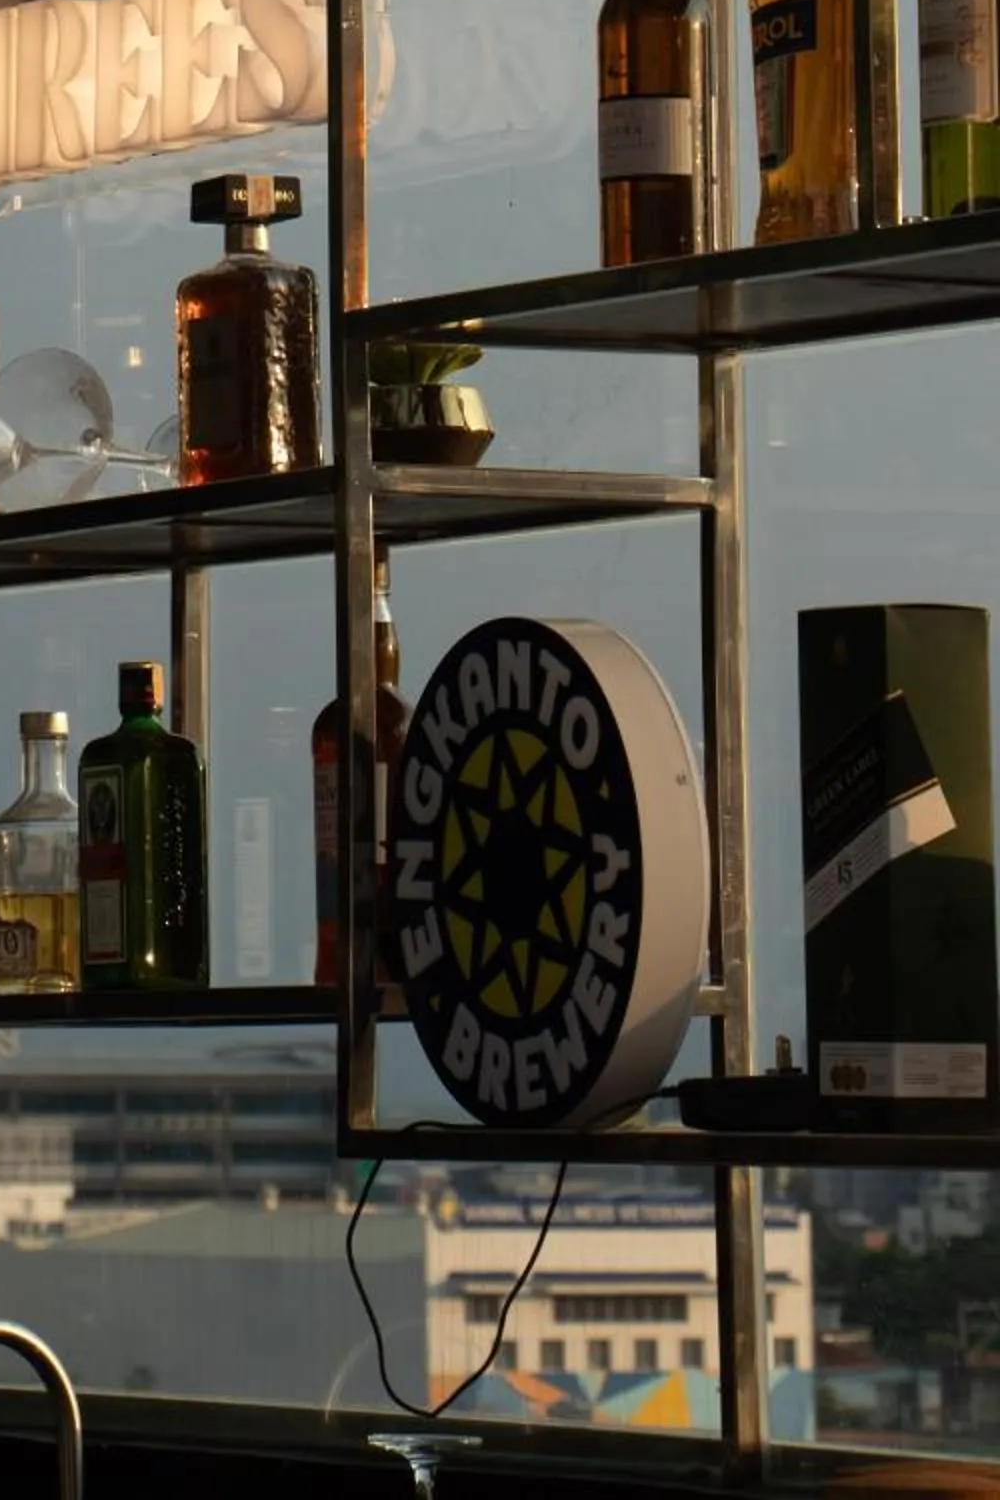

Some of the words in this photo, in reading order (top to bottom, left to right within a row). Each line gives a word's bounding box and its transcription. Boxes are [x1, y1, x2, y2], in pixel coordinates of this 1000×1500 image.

[396, 640, 600, 979] ENGKANTO
[836, 860, 852, 885] 15
[442, 832, 631, 1112] BREWERY
